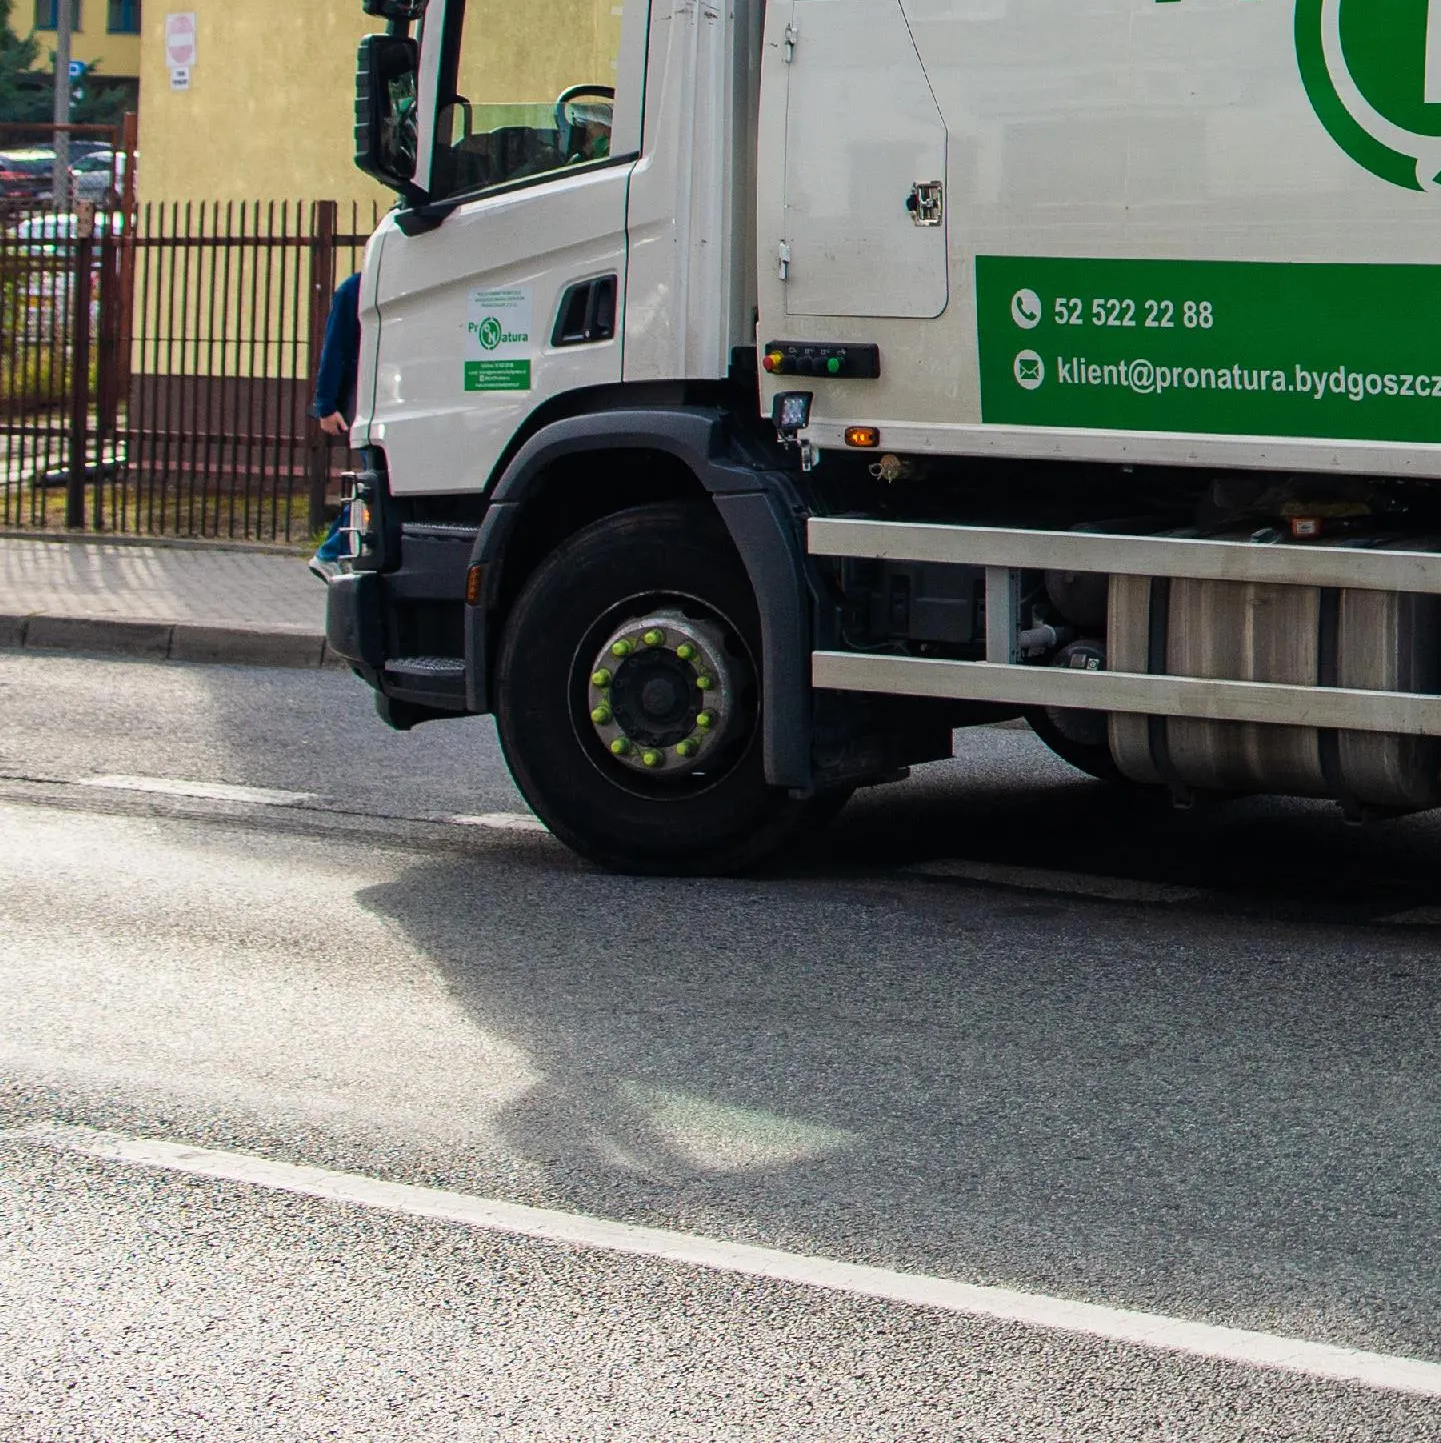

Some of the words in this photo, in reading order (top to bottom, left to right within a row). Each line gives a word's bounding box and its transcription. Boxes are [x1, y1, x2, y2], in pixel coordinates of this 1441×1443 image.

[1054, 297, 1084, 325] 52
[1091, 298, 1137, 327] 522
[1144, 299, 1175, 328] 22
[1183, 300, 1214, 329] 88
